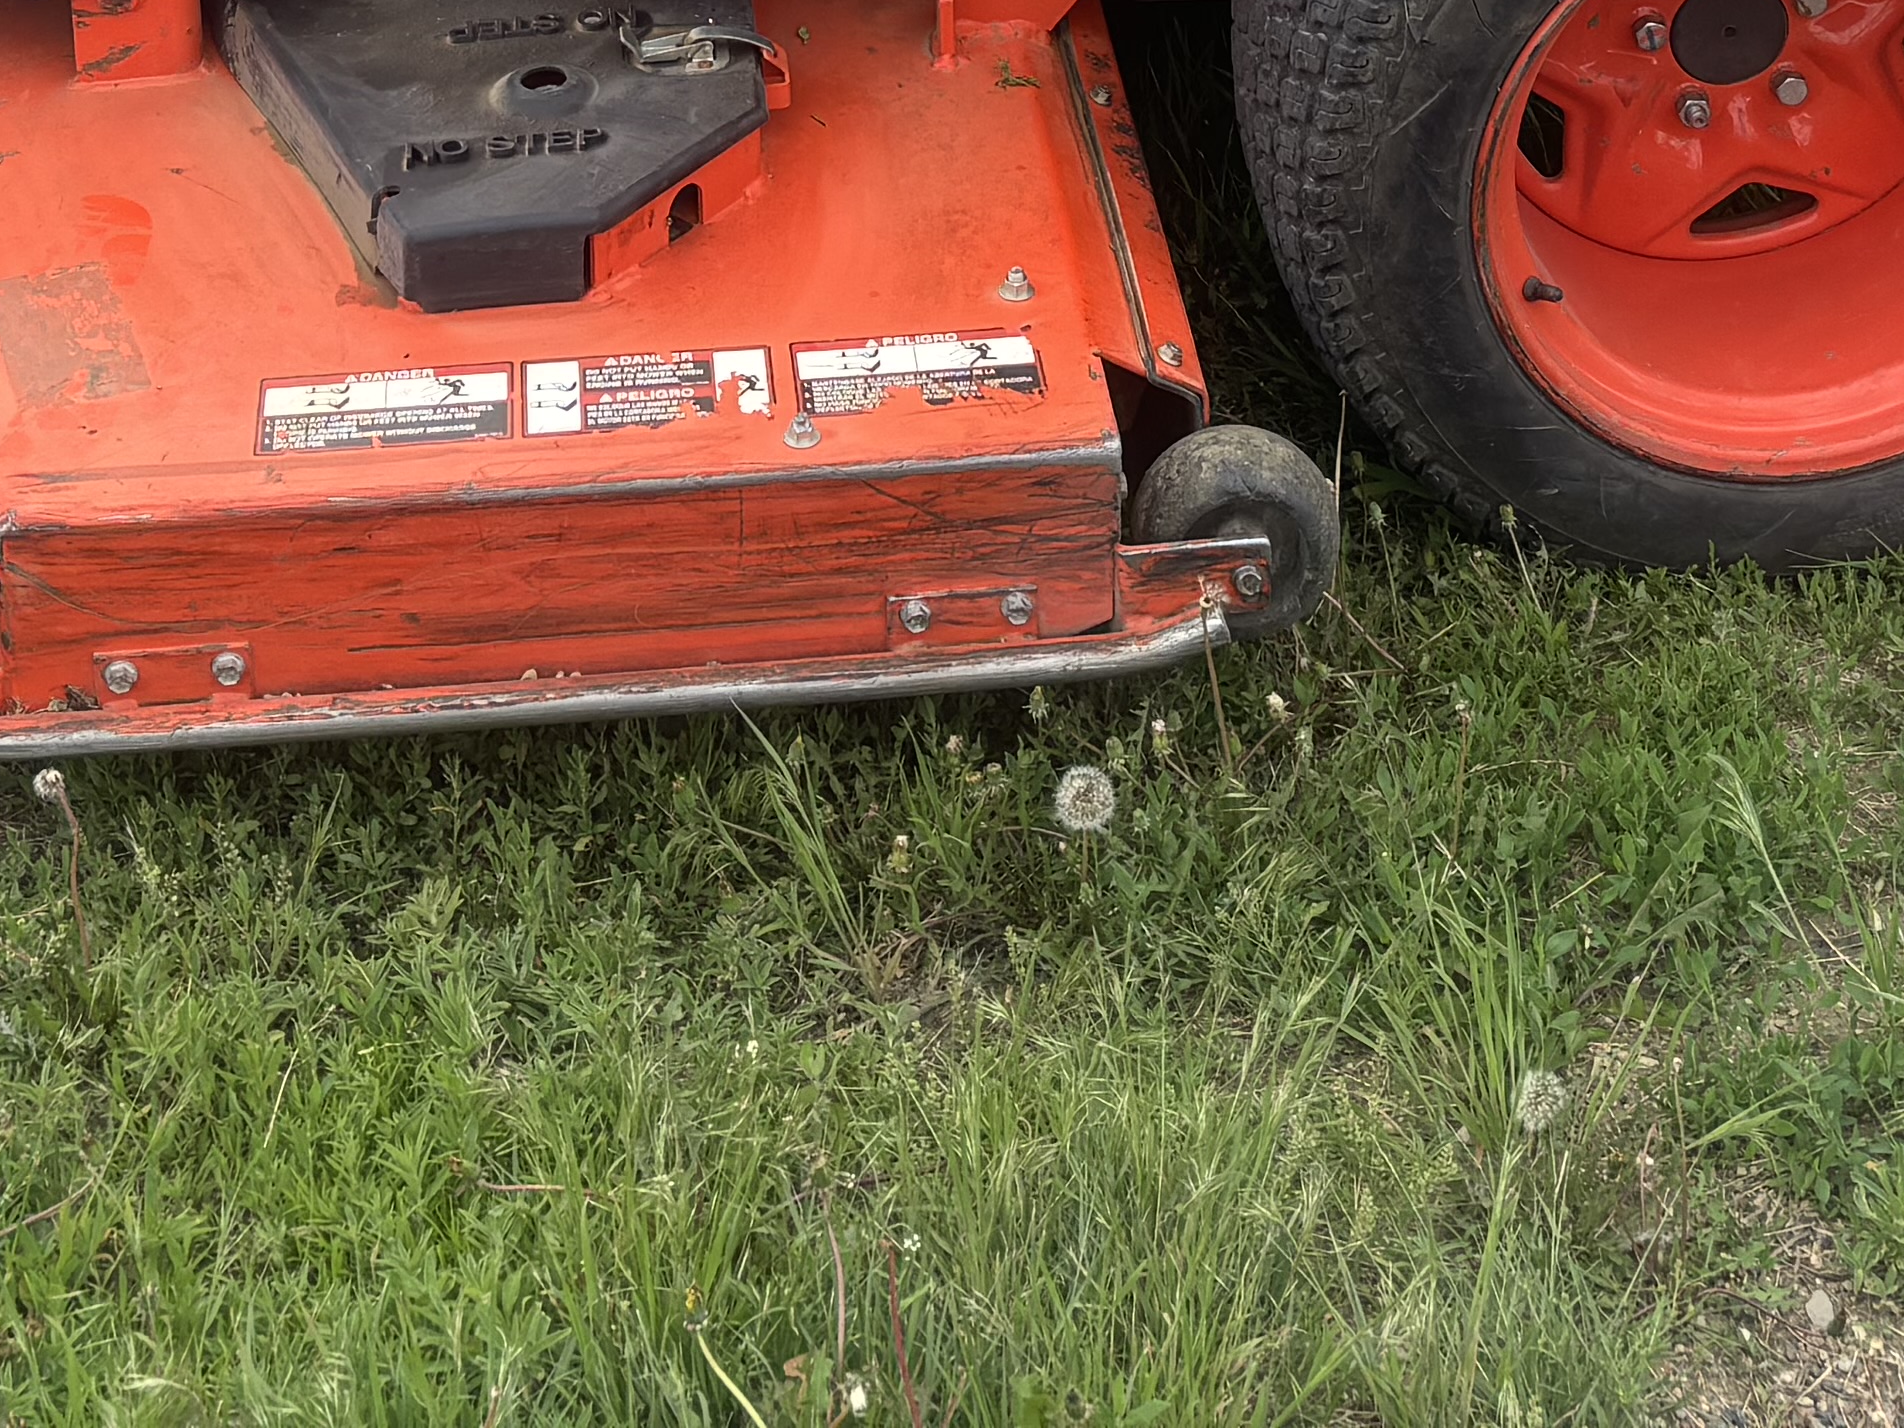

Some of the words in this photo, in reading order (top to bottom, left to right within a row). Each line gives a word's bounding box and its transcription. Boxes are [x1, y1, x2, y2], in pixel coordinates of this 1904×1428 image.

[402, 137, 469, 170] NO
[484, 126, 603, 159] STEP
[882, 333, 958, 347] PELIGRO
[362, 368, 435, 382] DANGER
[616, 388, 695, 401] PELIGRO
